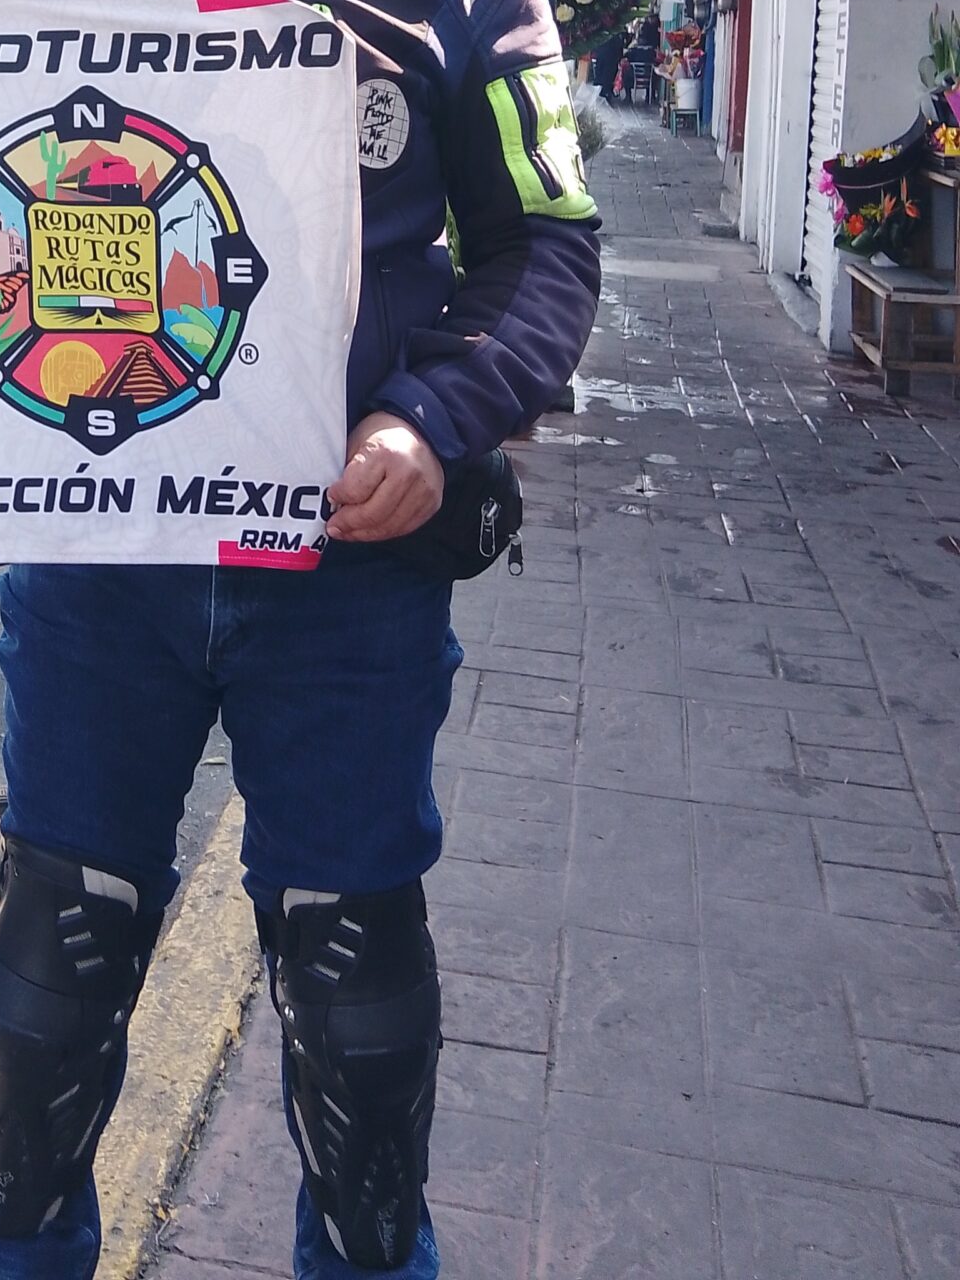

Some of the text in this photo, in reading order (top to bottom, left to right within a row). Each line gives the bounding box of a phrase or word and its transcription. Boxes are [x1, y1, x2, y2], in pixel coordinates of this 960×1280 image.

[368, 89, 394, 110] PINK
[74, 103, 105, 128] N
[227, 258, 254, 284] E
[87, 409, 116, 436] S
[240, 530, 303, 551] RRM
